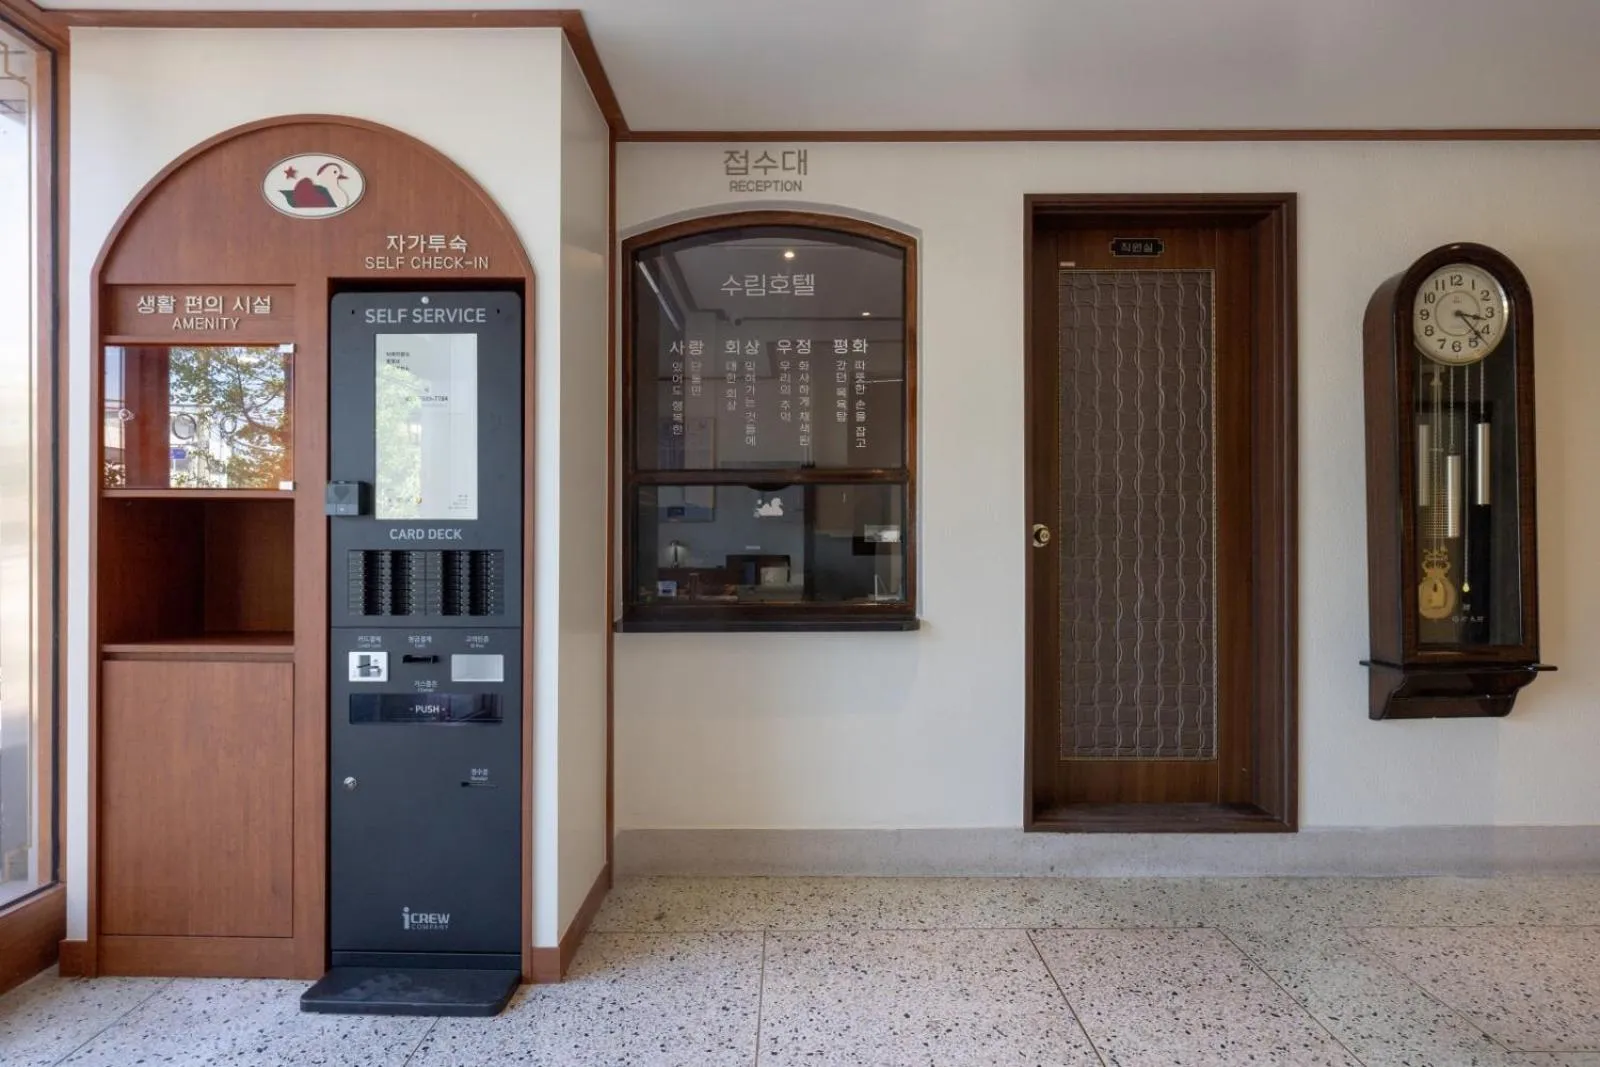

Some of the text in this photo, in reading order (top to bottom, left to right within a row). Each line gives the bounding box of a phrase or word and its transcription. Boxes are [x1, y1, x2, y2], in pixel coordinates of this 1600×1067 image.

[723, 149, 808, 176] 접수대
[729, 180, 802, 192] RECEPTION
[387, 233, 468, 254] 자가투숙
[365, 256, 489, 270] SELF CHECK-IN
[720, 273, 816, 297] 수림호텔
[1435, 279, 1445, 290] 11
[1450, 274, 1464, 286] 12
[1424, 292, 1435, 303] 10
[1480, 290, 1491, 301] 2
[136, 295, 272, 315] 생활 편의 시설
[365, 308, 486, 323] SELF SERVICE
[1419, 309, 1430, 320] 9
[1485, 307, 1494, 318] 3
[172, 317, 241, 331] AMENITY
[1481, 324, 1490, 335] 4
[1424, 325, 1434, 336] 8
[669, 339, 704, 355] 사랑
[725, 338, 760, 355] 회상
[776, 339, 811, 354] 우정
[833, 338, 868, 354] 평화
[1437, 339, 1446, 349] 7
[1452, 341, 1462, 352] 6
[1468, 337, 1479, 348] 5
[389, 529, 462, 540] CARD DECK
[415, 705, 440, 713] PUSH
